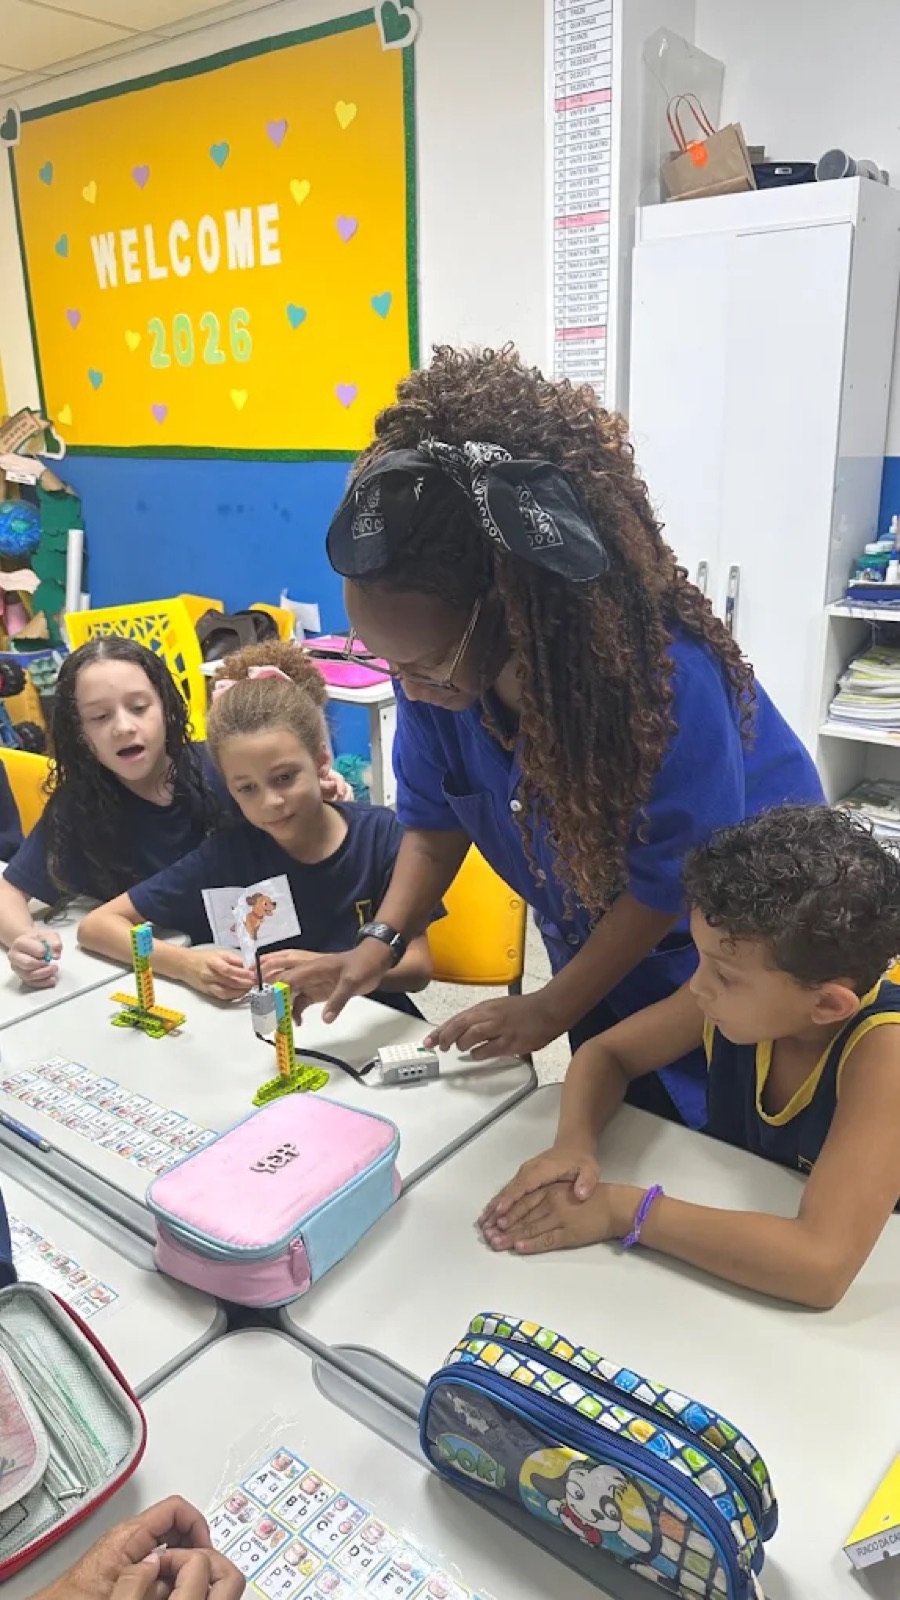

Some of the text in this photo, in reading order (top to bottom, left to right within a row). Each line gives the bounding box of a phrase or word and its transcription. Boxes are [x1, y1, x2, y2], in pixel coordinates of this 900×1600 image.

[90, 203, 281, 289] WELCOME
[148, 307, 253, 368] 2026
[287, 1495, 298, 1506] B
[298, 1506, 307, 1516] b
[316, 1520, 338, 1541] C c
[239, 1541, 251, 1553] O
[349, 1545, 360, 1556] D
[878, 1537, 890, 1549] DA
[381, 1572, 394, 1585] E
